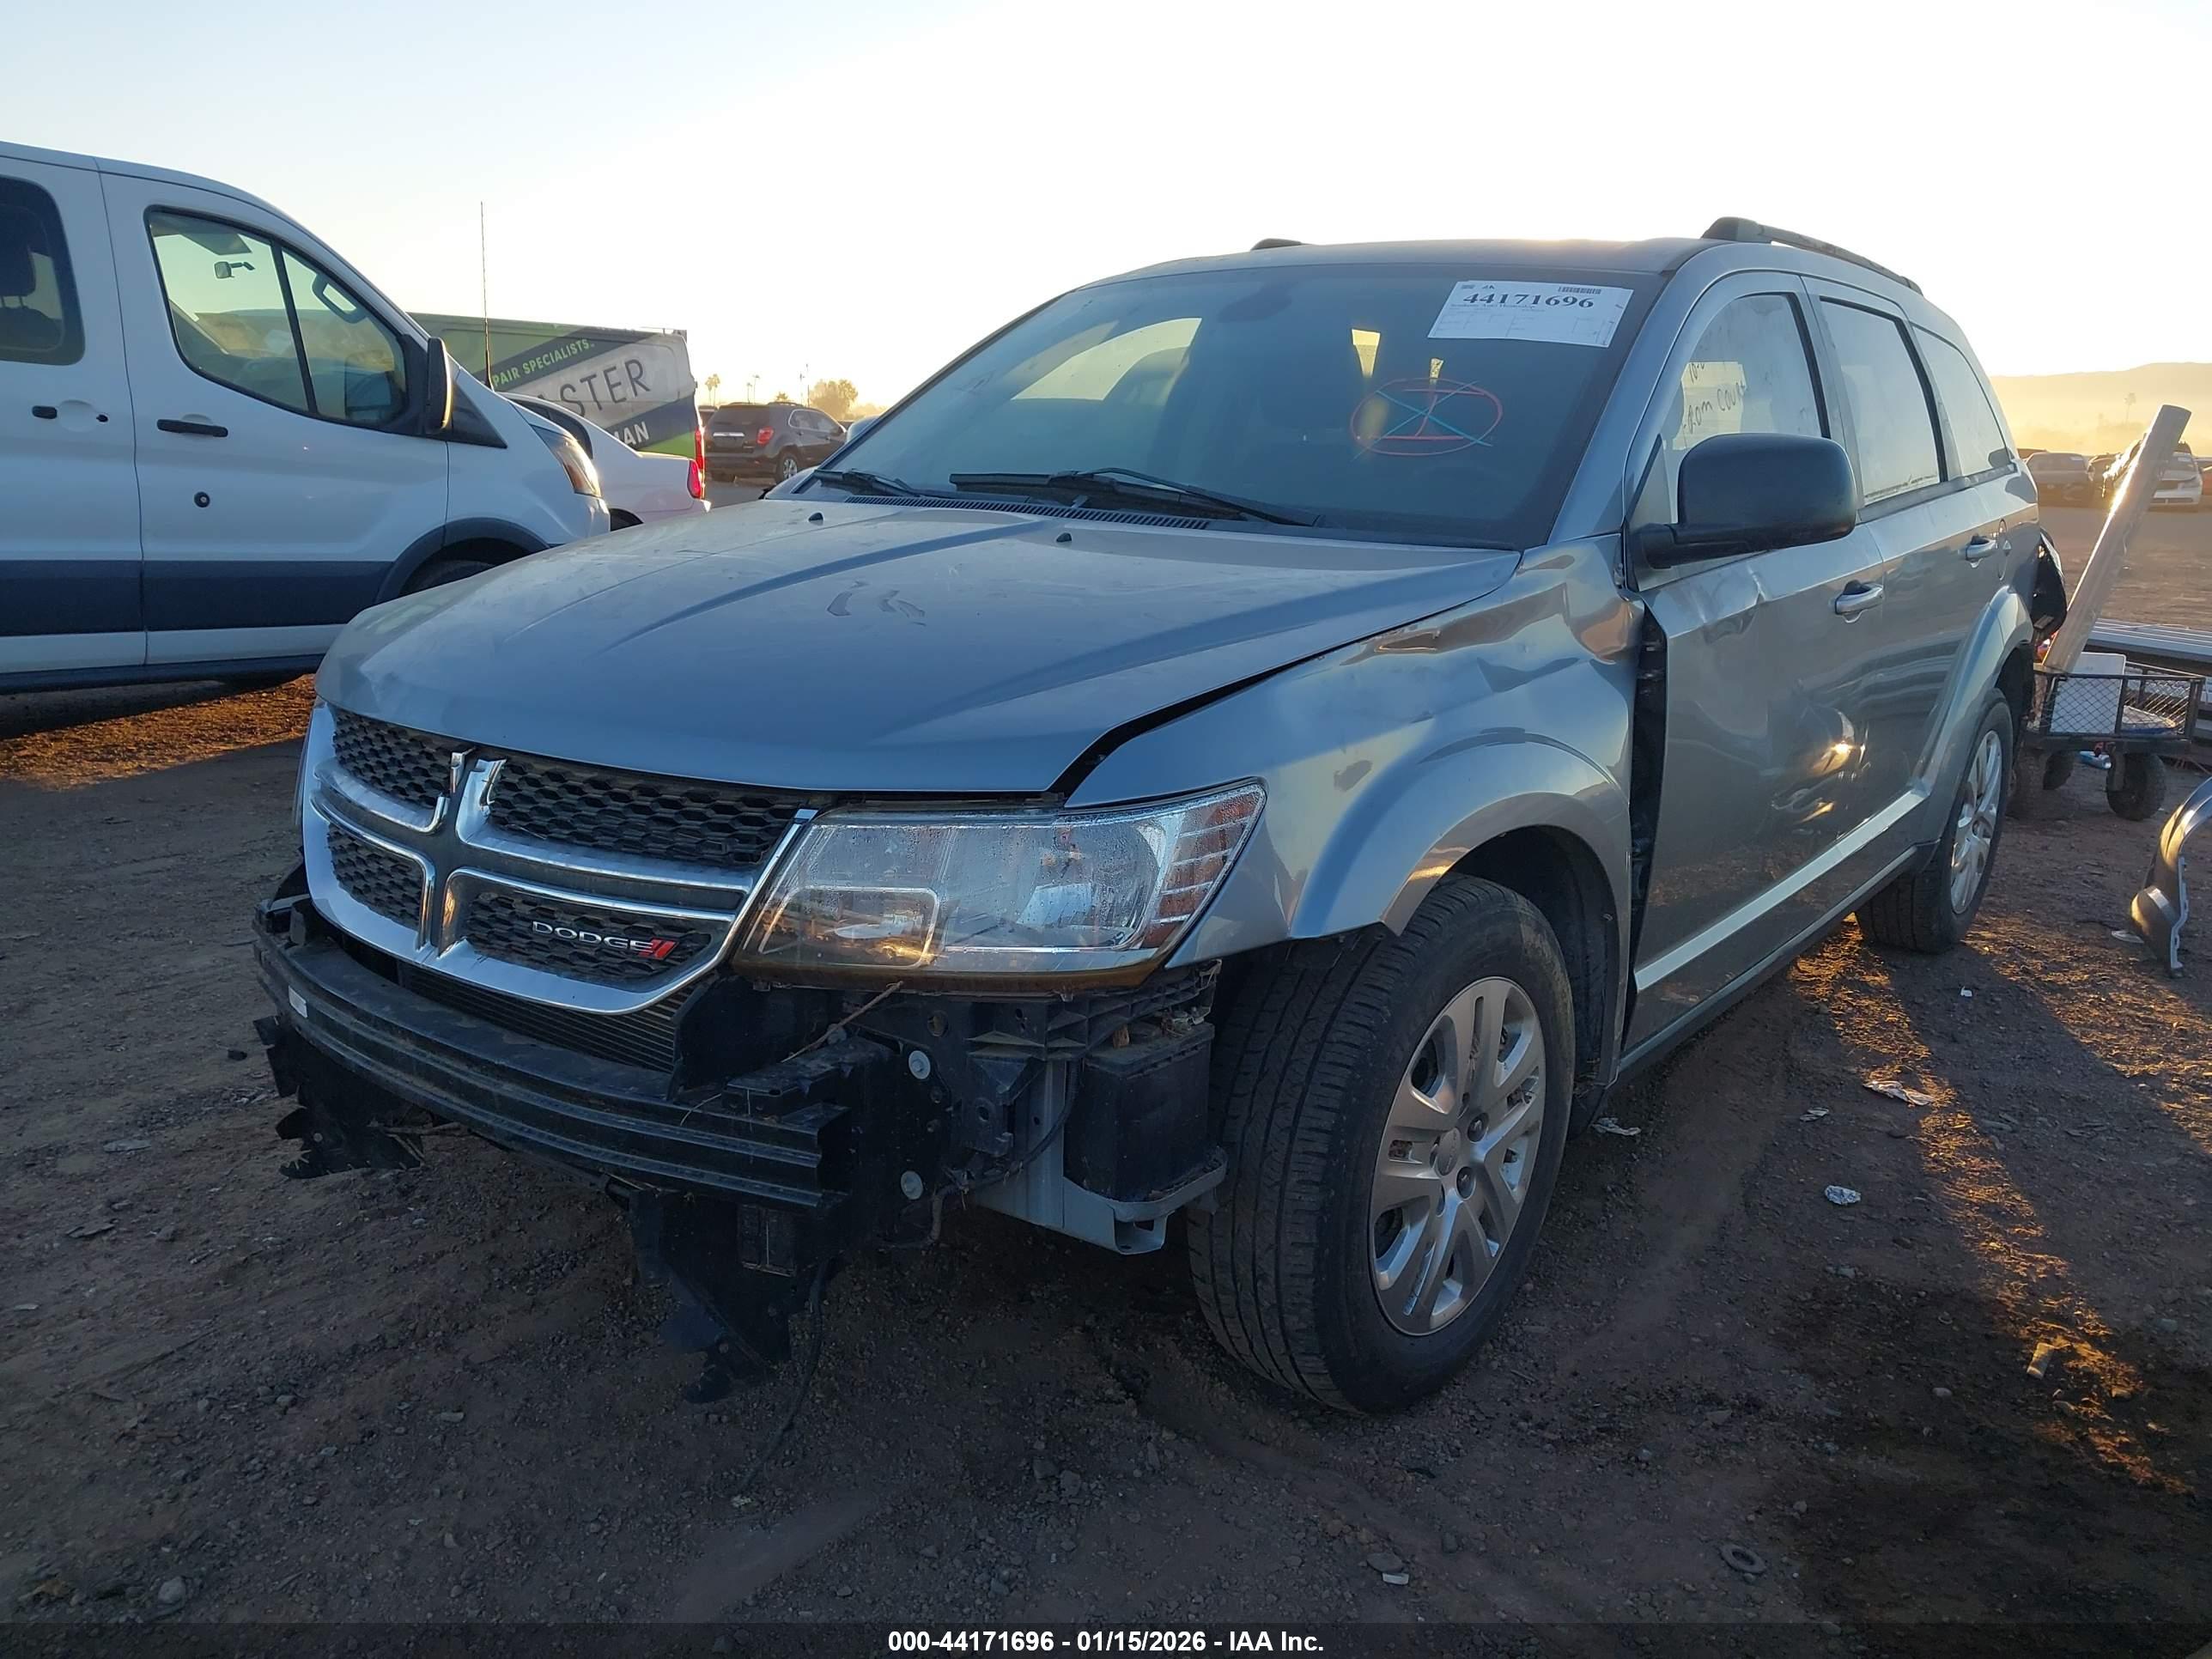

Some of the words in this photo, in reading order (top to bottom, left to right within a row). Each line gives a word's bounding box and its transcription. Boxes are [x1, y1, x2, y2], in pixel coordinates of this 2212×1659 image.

[1462, 293, 1595, 308] 44171696
[491, 367, 520, 387] PAIR
[538, 359, 651, 417] STER
[613, 421, 649, 446] AN
[532, 921, 653, 954] DODGE
